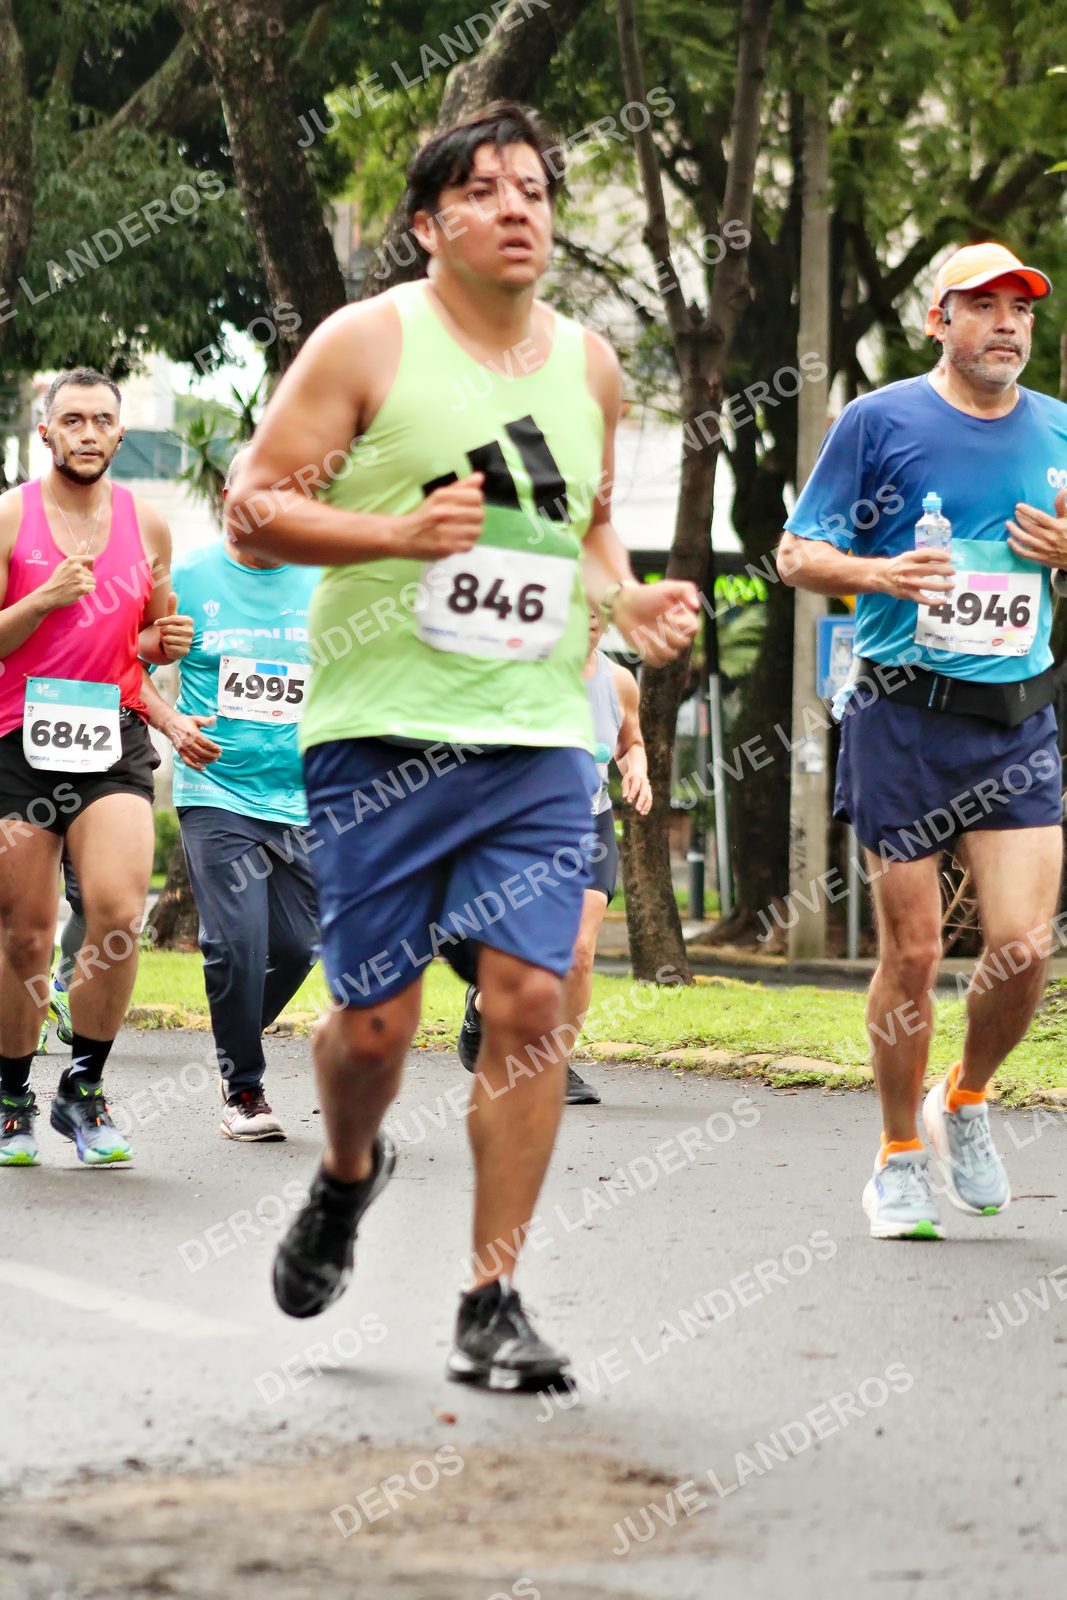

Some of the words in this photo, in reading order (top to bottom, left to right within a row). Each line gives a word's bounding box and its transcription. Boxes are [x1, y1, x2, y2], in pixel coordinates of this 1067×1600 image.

[448, 573, 547, 623] 846
[928, 592, 1031, 628] 4946
[224, 672, 305, 704] 4995
[30, 719, 113, 752] 6842
